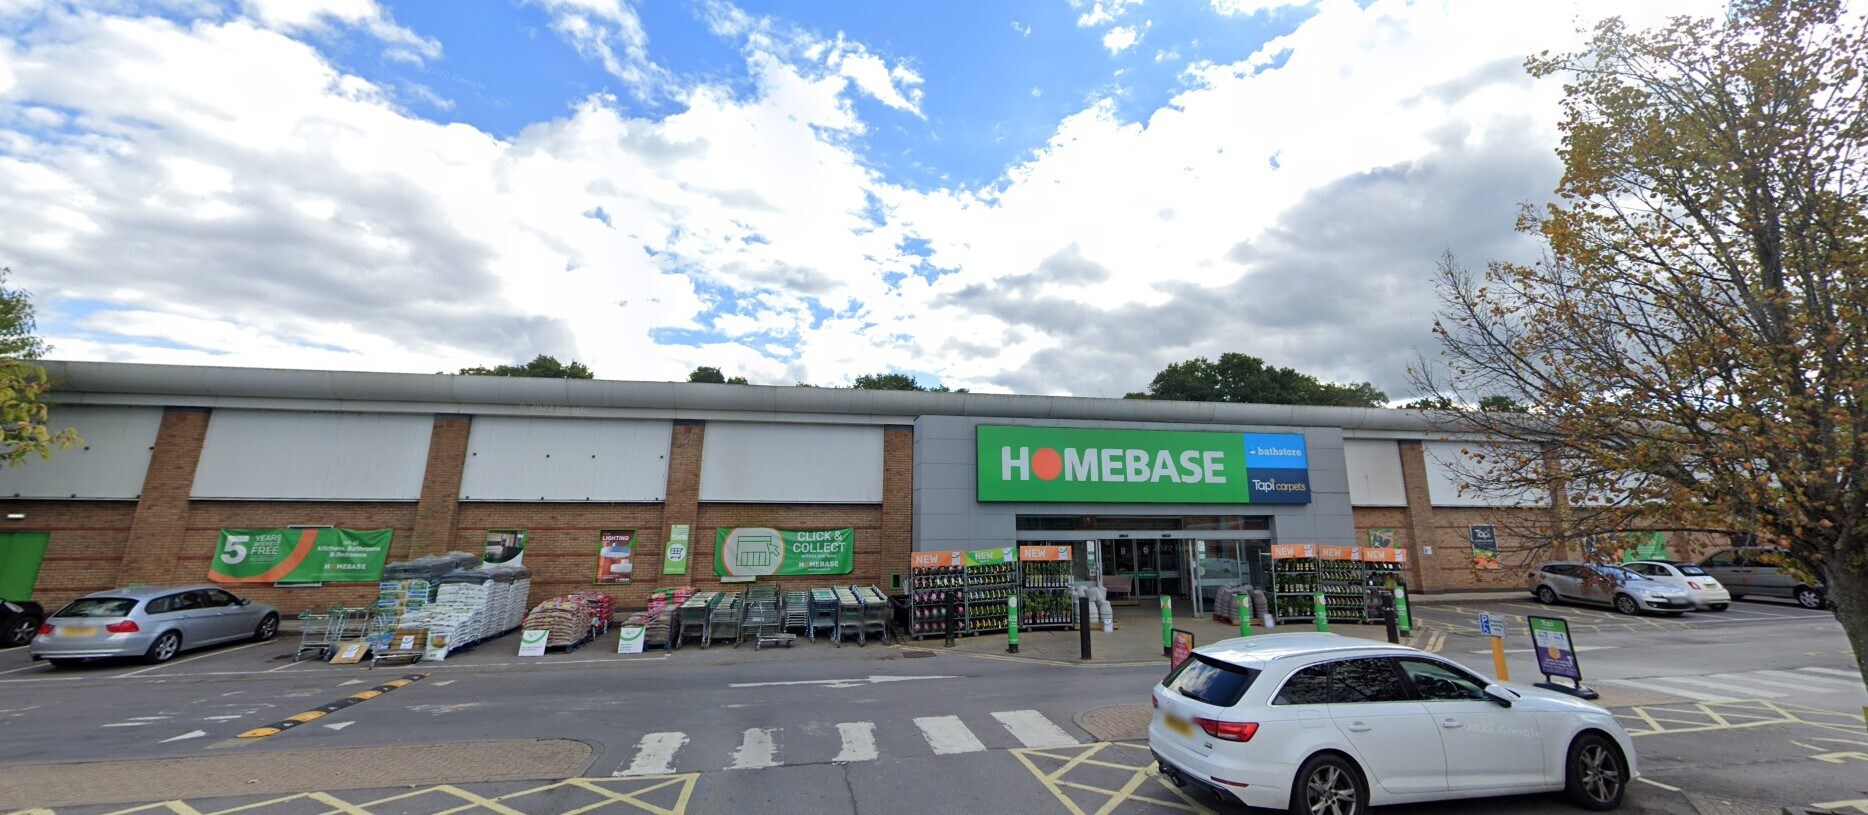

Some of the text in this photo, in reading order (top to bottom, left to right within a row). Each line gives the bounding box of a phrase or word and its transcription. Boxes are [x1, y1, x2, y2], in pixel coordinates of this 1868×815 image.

[1257, 447, 1302, 456] bathstore
[1001, 446, 1226, 483] HOMEBASE
[1252, 478, 1306, 493] Tapi carpets
[255, 534, 281, 542] YEARS
[797, 530, 842, 541] CLICK &
[221, 535, 250, 565] 5
[251, 546, 279, 555] FREE
[793, 542, 846, 553] COLLECT
[1275, 547, 1294, 555] NEW
[1322, 548, 1342, 556] NEW
[974, 552, 993, 560] NEW
[1024, 549, 1046, 558] NEW
[1367, 550, 1385, 558] NEW
[915, 554, 938, 564] NEW
